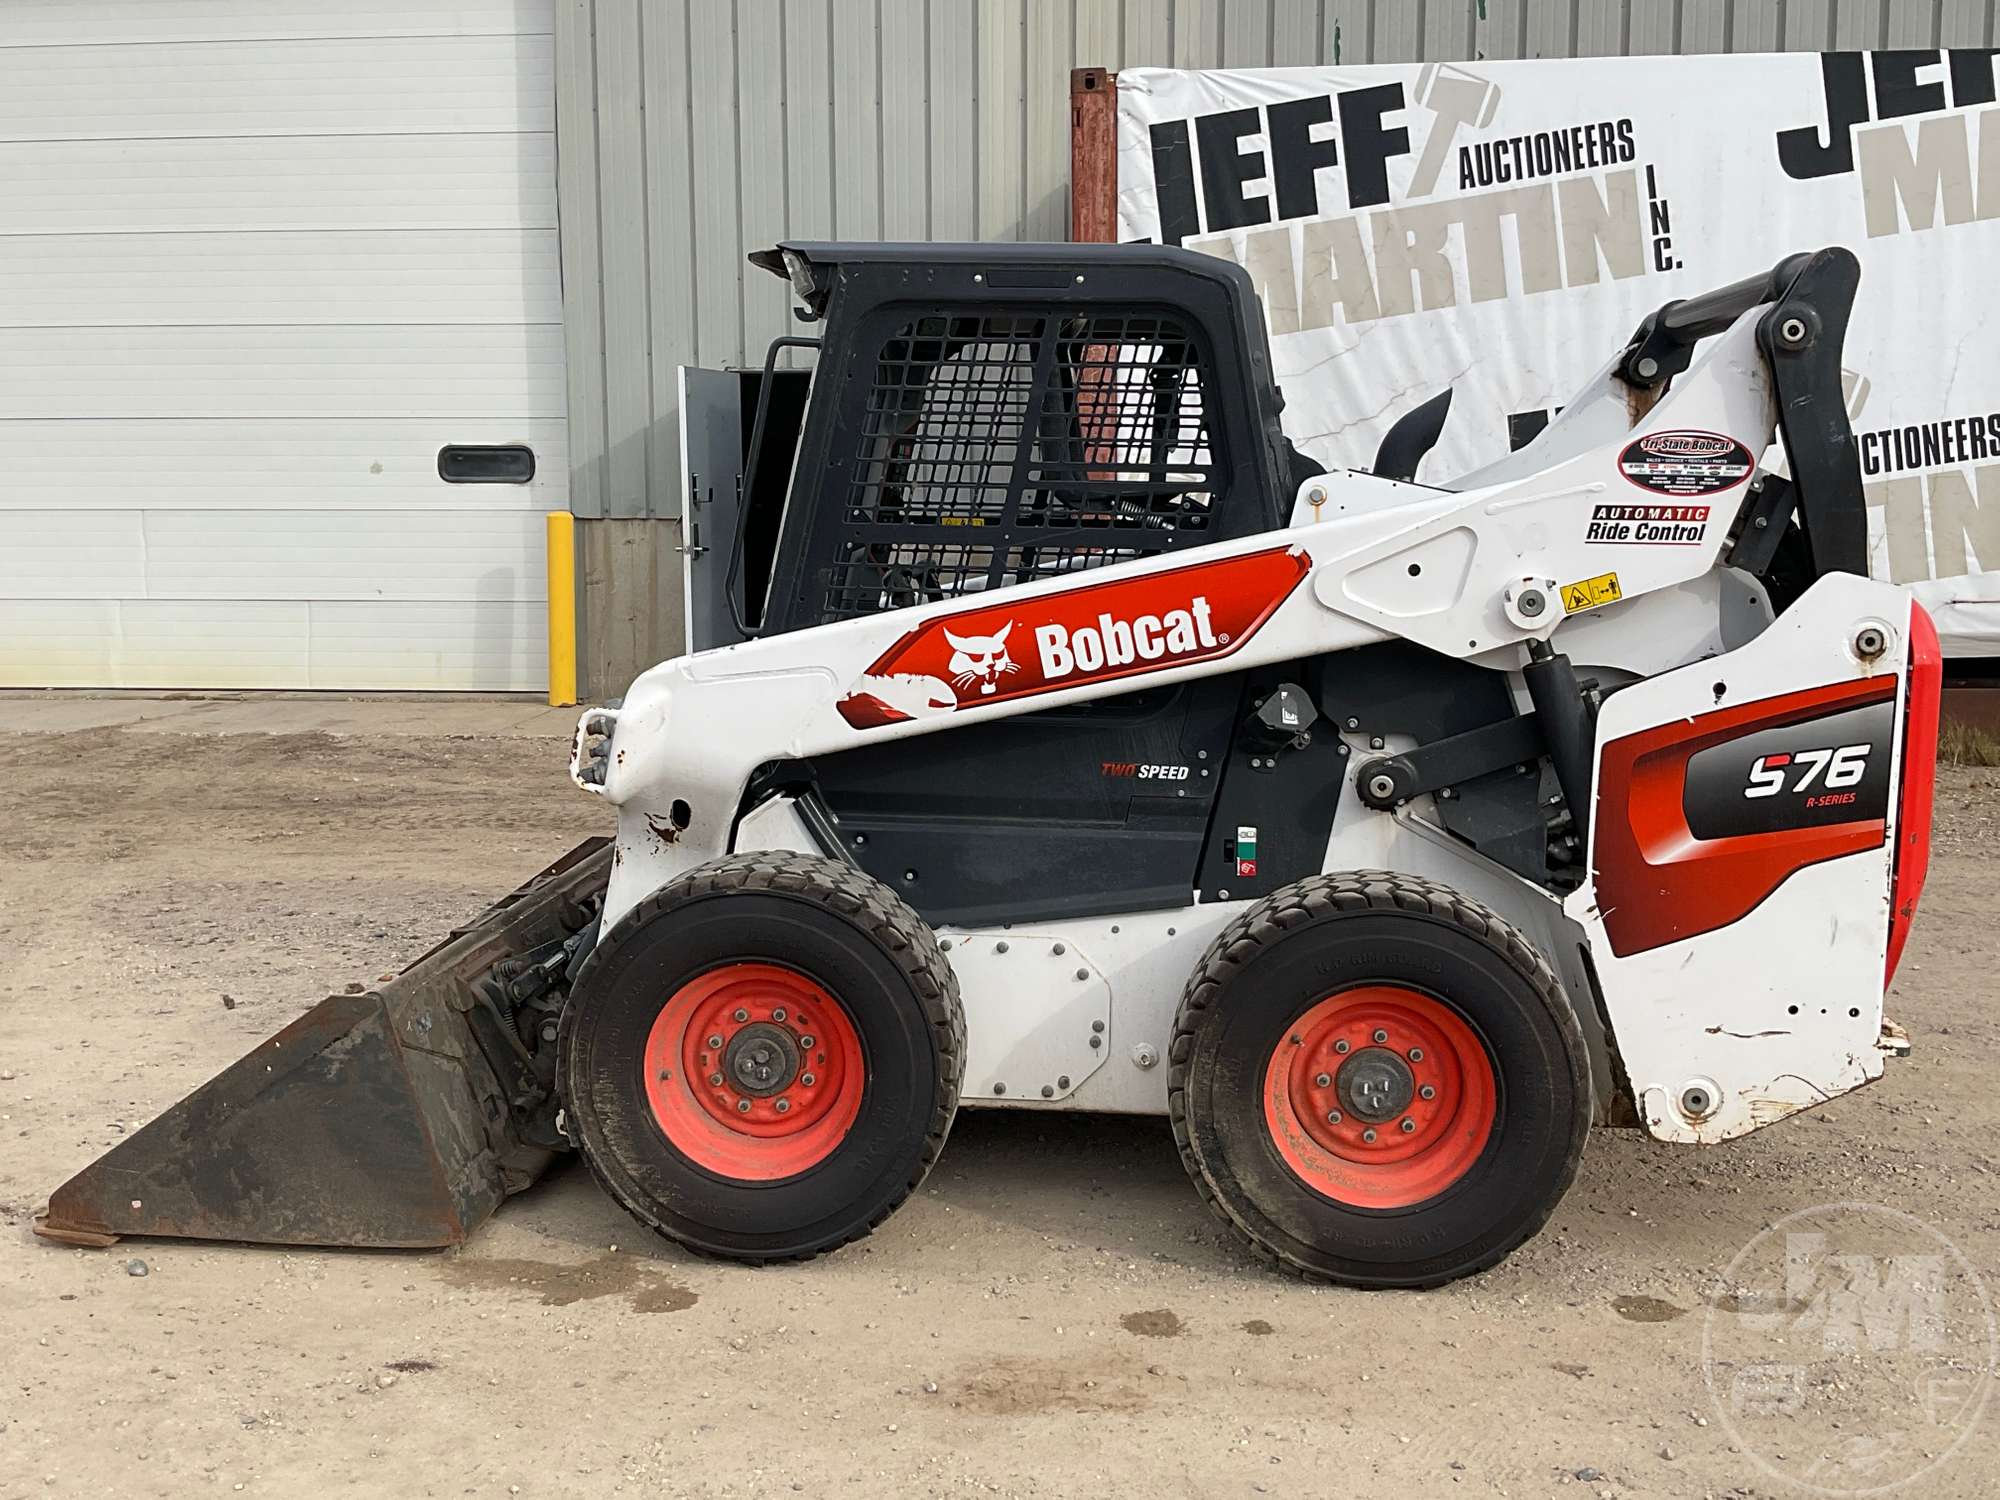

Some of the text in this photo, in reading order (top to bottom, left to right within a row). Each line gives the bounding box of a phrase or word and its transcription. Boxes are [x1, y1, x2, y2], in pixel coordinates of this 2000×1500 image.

[1148, 82, 1411, 248] JEFF
[1459, 118, 1636, 190] AUCTIONEERS
[1857, 108, 2000, 239] M
[1646, 164, 1683, 272] INC.
[1644, 437, 1730, 451] Tri-State Bobcat
[1854, 413, 2000, 475] CTIONEERS
[1586, 522, 1706, 541] Ride Control
[1597, 507, 1706, 520] AUTOMATIC
[1102, 762, 1189, 780] TWO SPEED
[1744, 744, 1871, 798] S76
[1806, 792, 1857, 808] R-SERIES
